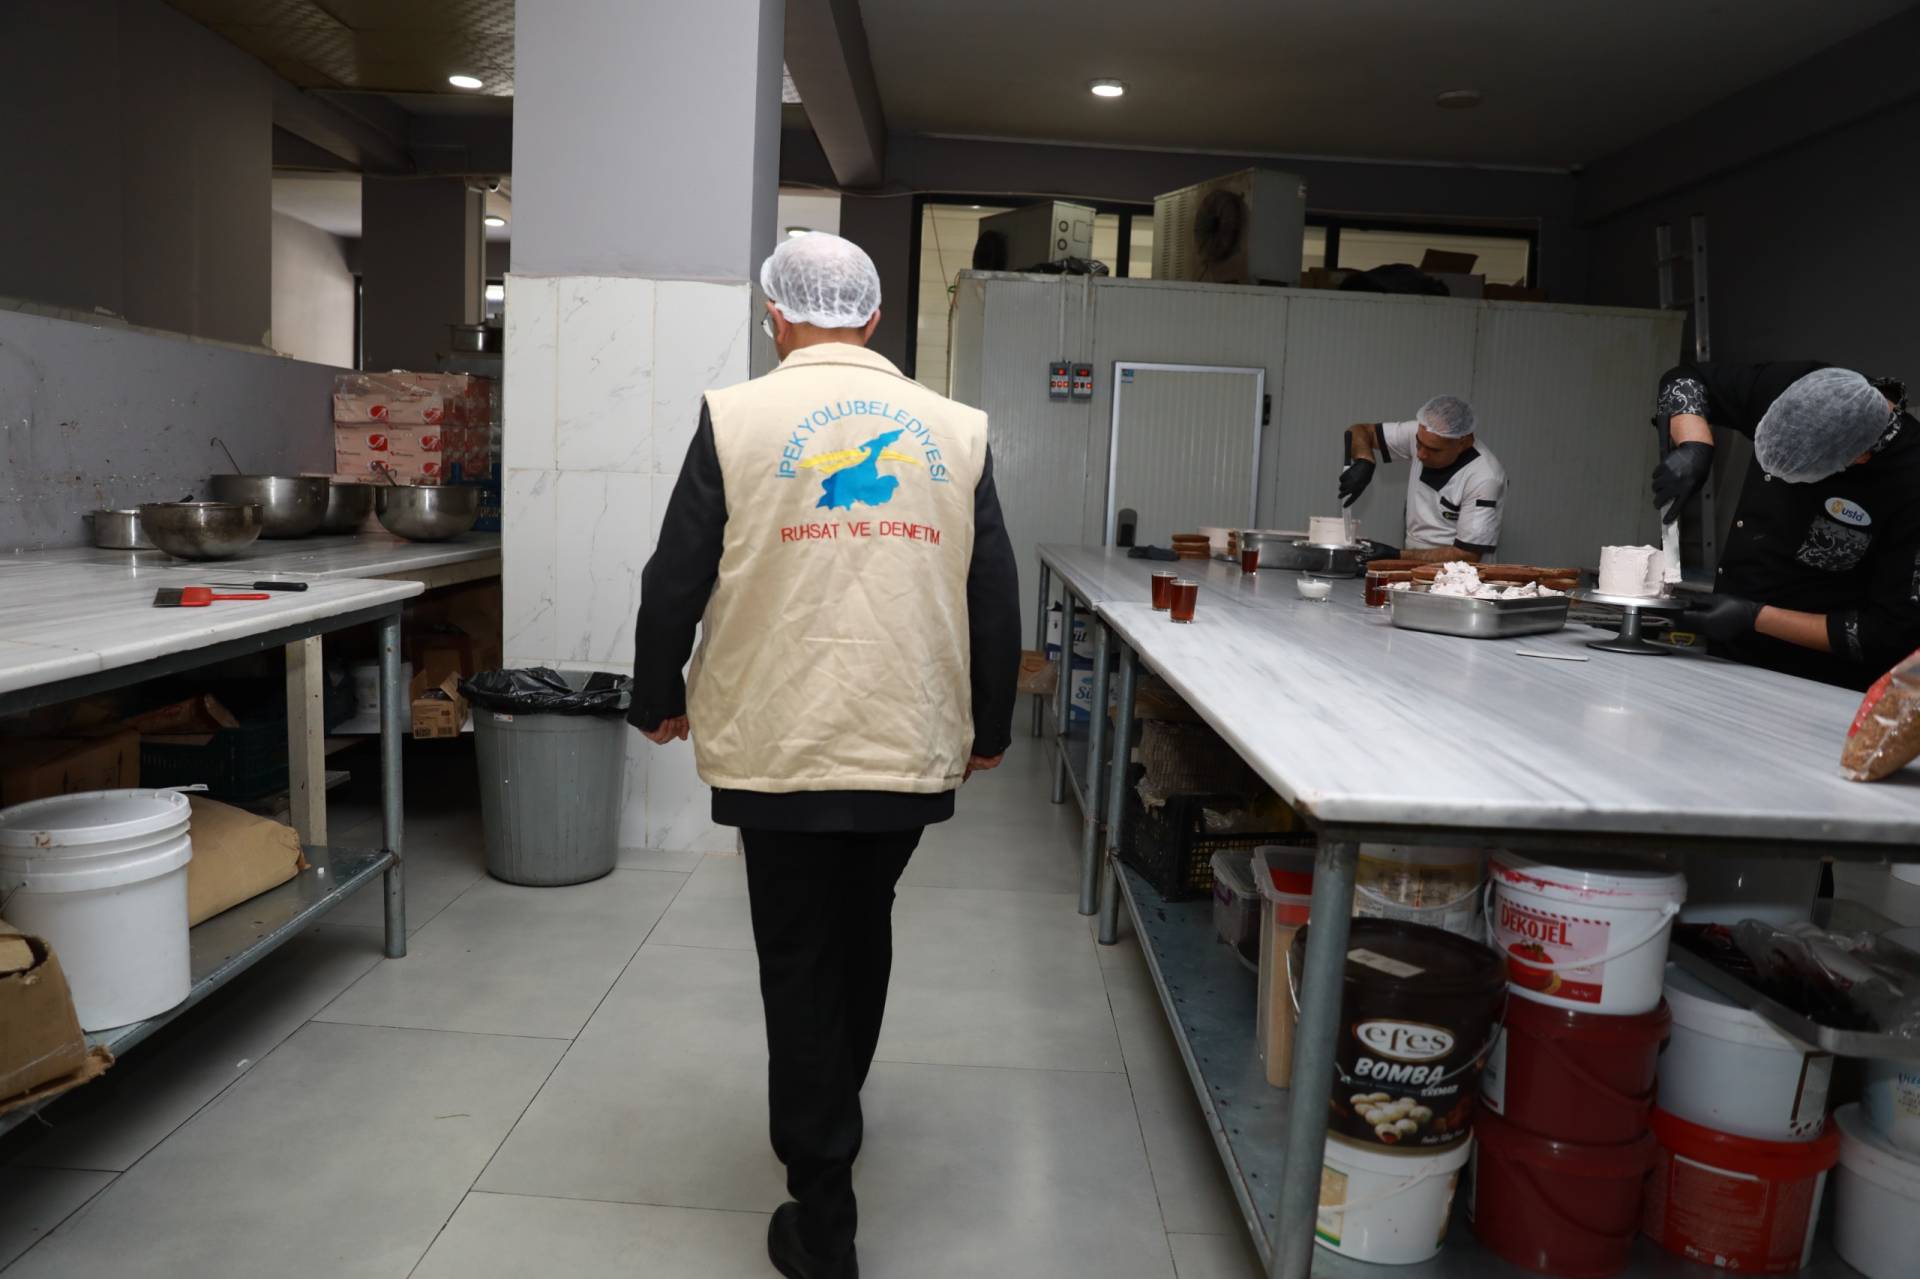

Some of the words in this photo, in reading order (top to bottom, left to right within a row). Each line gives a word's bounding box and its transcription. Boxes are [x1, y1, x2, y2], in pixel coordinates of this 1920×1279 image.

[780, 523, 840, 543] RUHSAT
[847, 521, 872, 538] VE
[1500, 903, 1573, 946] DEKOJEL
[1364, 1026, 1447, 1051] efes
[1354, 1057, 1445, 1086] BOMBA
